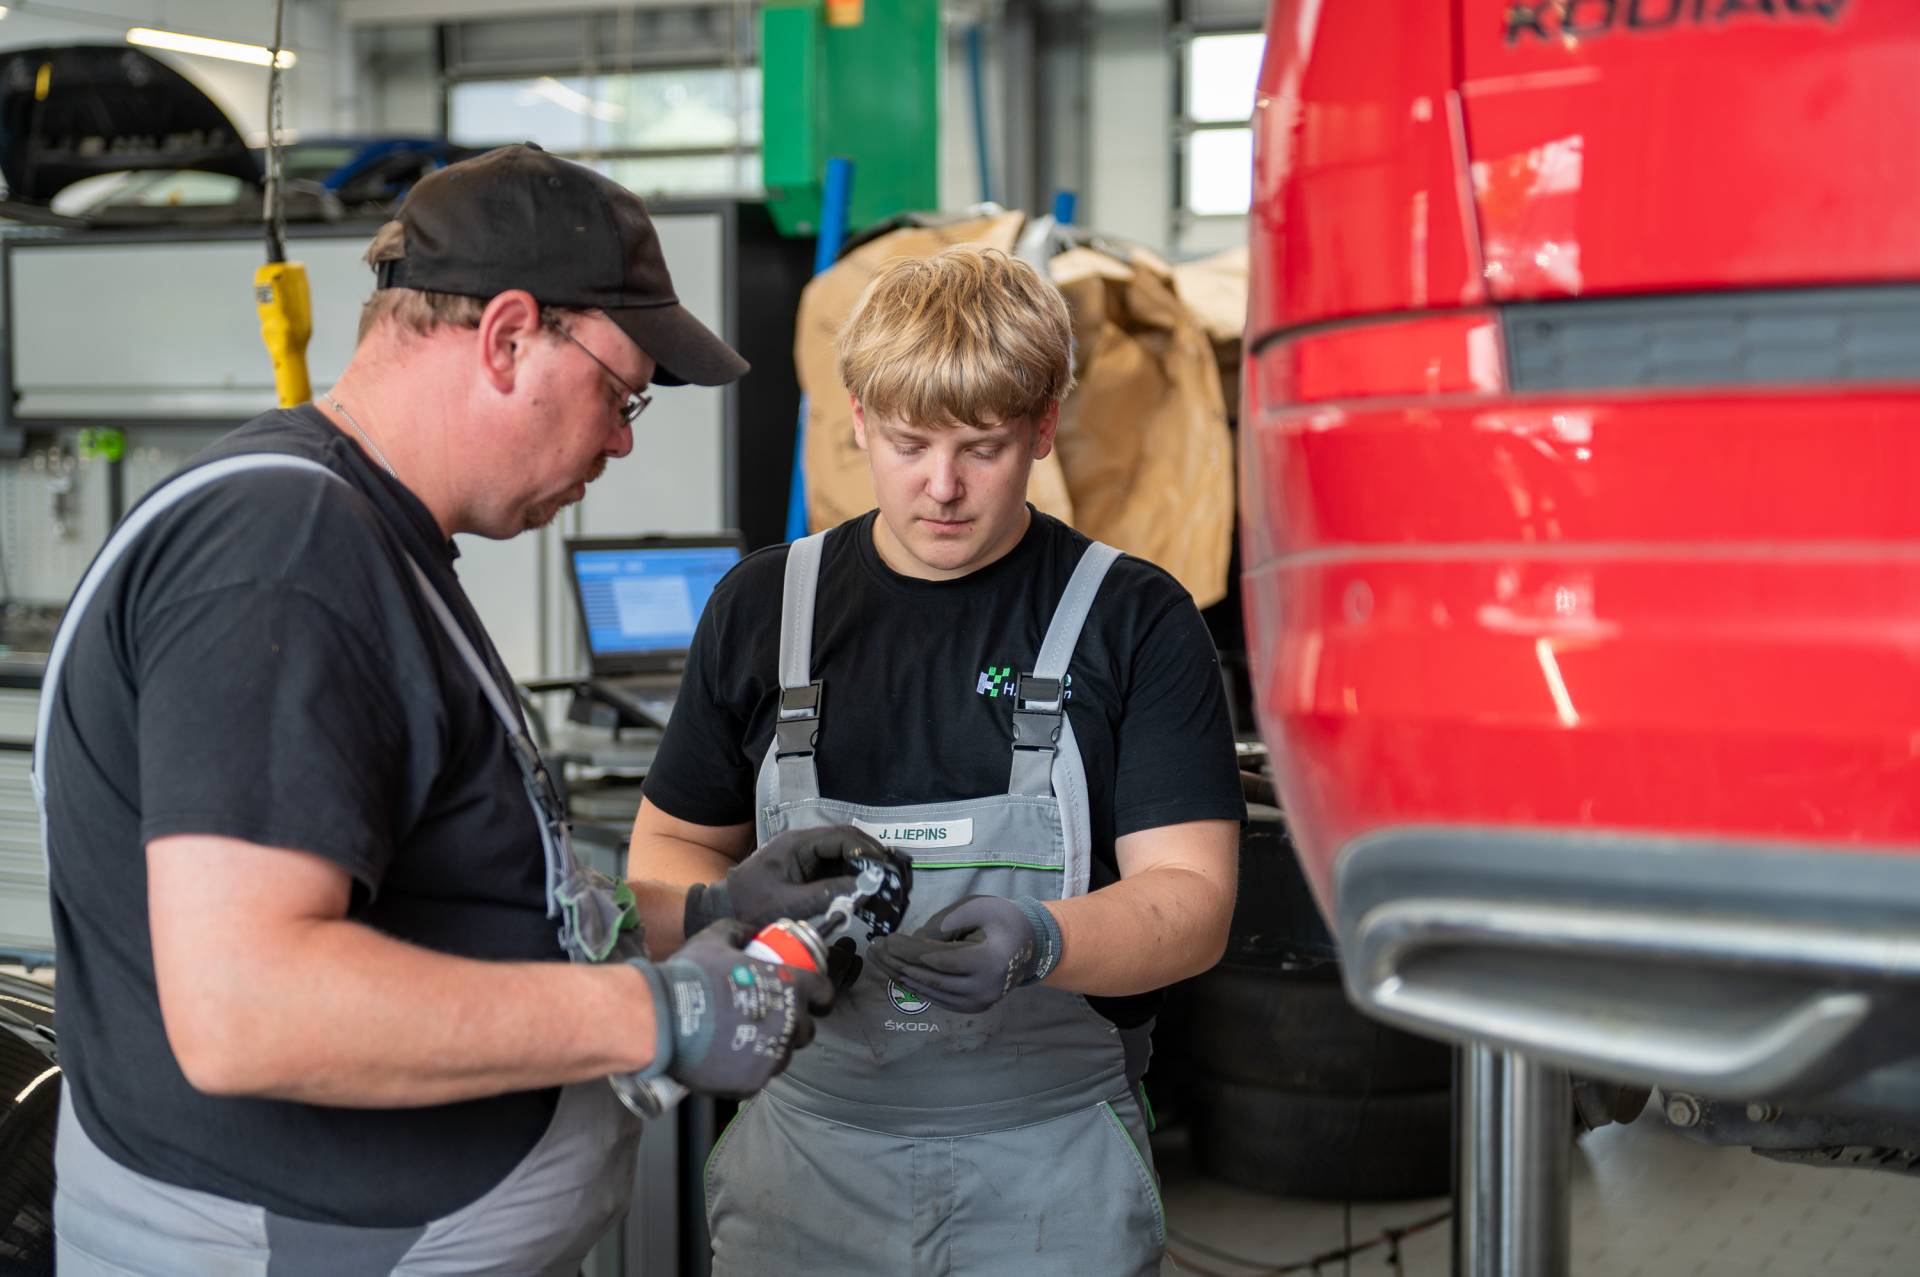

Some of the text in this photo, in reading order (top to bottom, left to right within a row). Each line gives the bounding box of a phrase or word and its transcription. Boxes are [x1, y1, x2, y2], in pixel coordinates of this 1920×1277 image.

[879, 828, 948, 840] J. LIEPINS
[884, 1019, 941, 1033] ŠKODA
